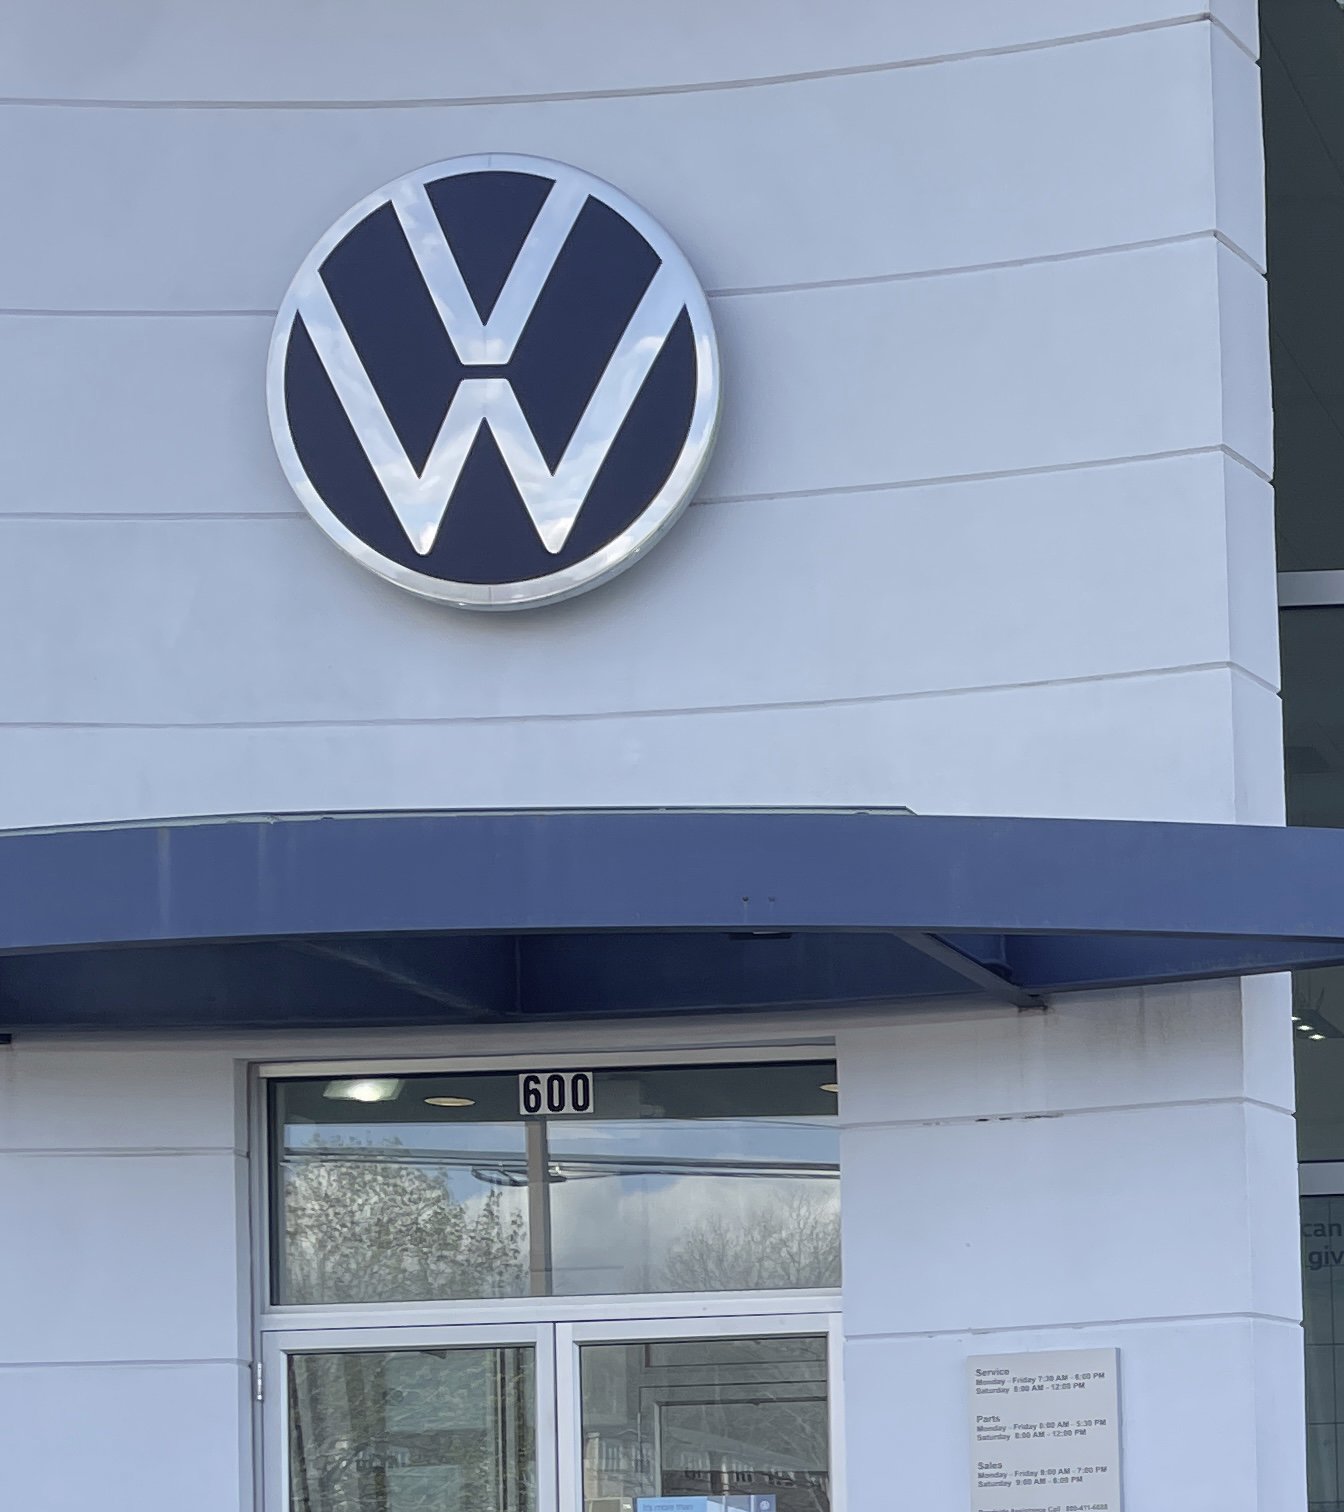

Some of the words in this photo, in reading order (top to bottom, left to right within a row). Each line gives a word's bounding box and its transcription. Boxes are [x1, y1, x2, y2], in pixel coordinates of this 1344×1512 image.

[523, 1073, 590, 1113] 600
[975, 1368, 1010, 1377] Service
[976, 1415, 1001, 1423] Parts
[1013, 1423, 1037, 1431] Friday
[977, 1461, 1003, 1470] Sales
[1014, 1470, 1038, 1478] Friday
